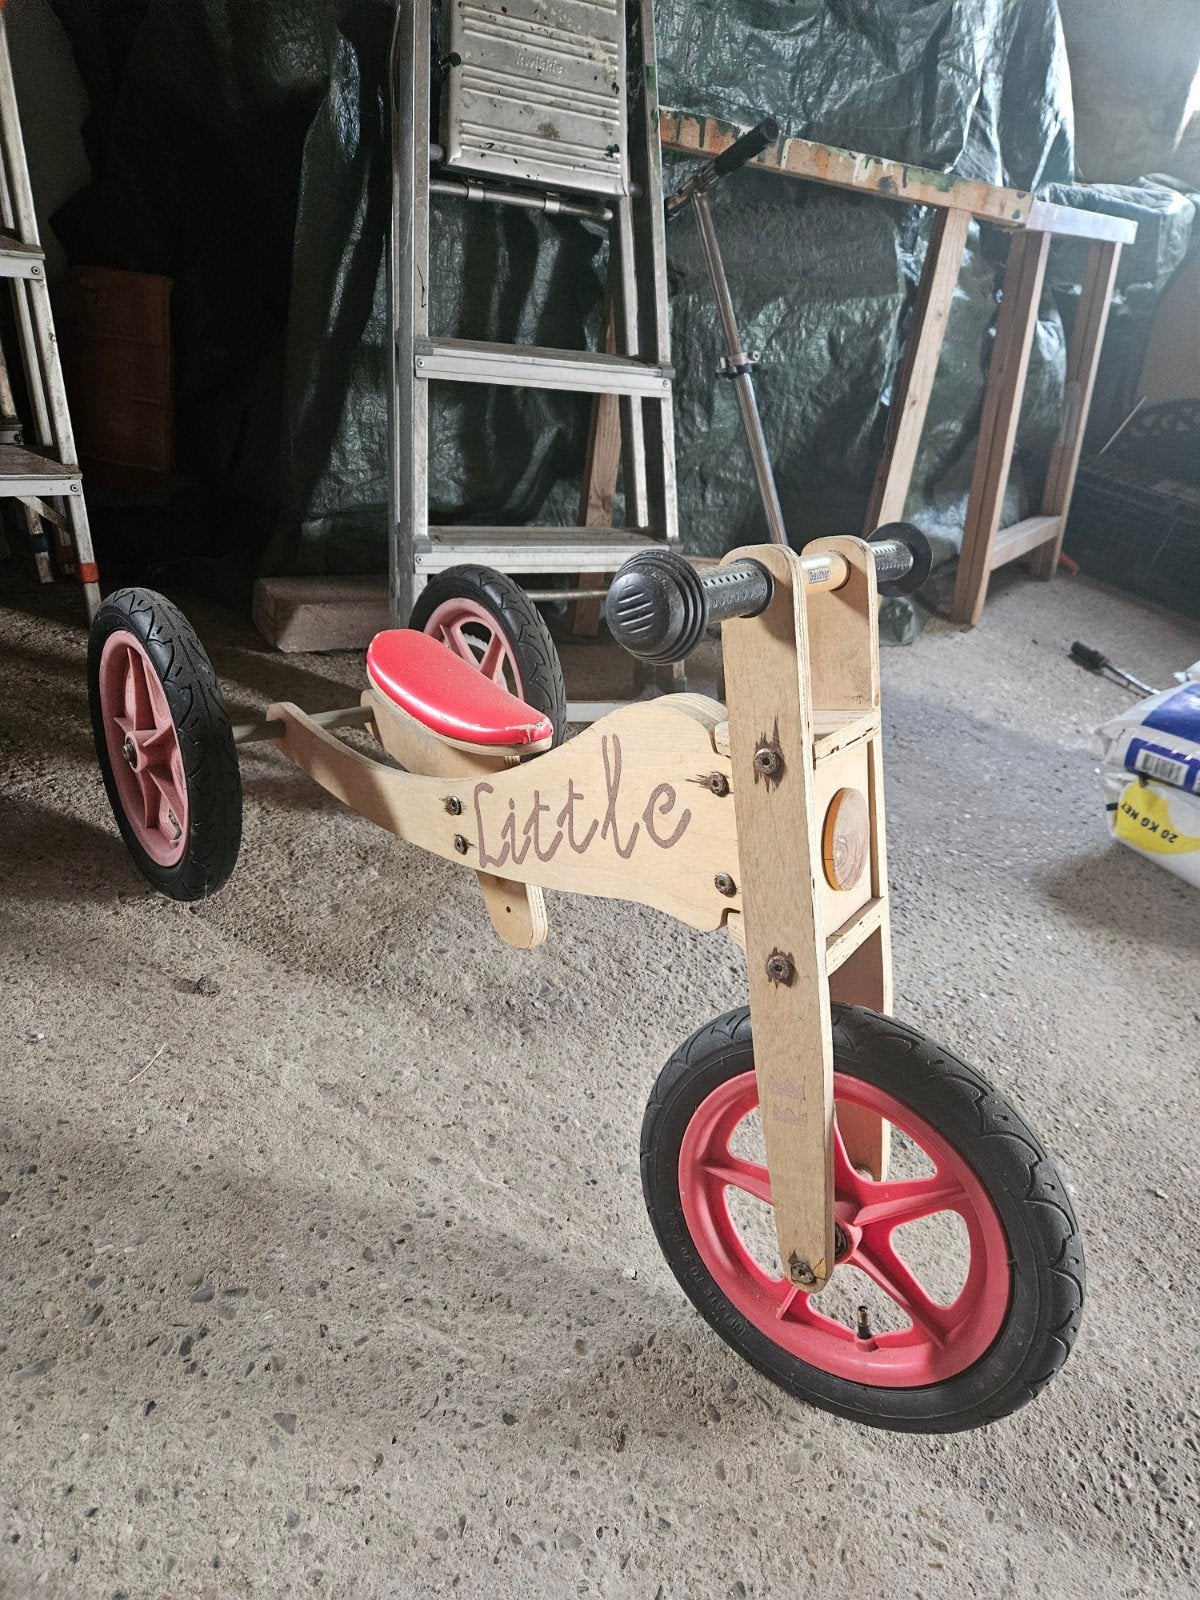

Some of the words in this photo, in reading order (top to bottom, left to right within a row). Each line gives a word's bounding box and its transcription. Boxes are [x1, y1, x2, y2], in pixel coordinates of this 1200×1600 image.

[474, 734, 691, 868] Little
[1141, 818, 1160, 832] KG
[1161, 829, 1178, 844] 20
